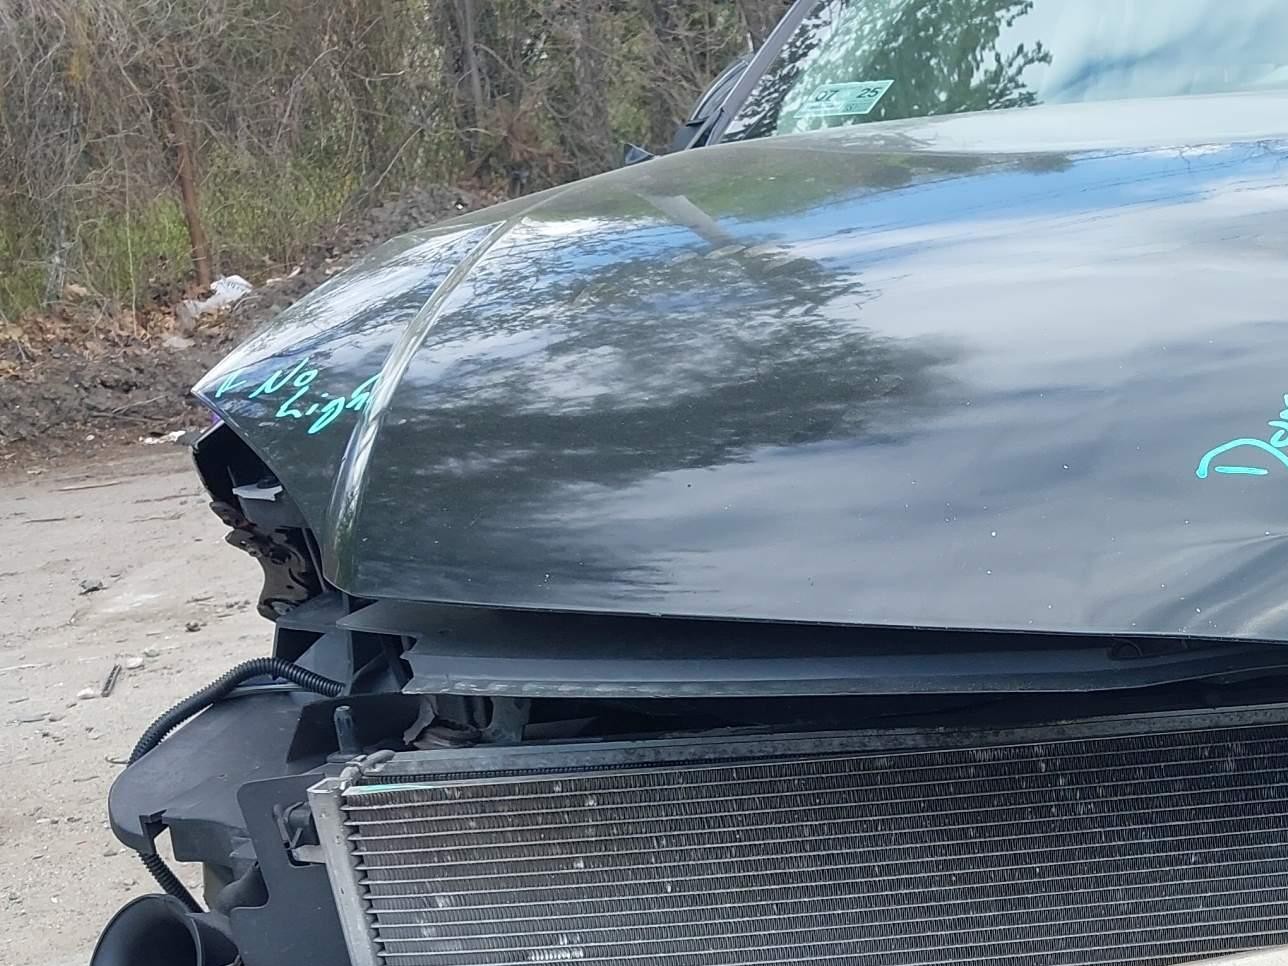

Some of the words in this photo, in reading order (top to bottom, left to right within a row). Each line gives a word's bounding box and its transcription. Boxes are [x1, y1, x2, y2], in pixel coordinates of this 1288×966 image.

[815, 89, 839, 102] 07
[856, 86, 883, 99] 25
[248, 356, 319, 399] No
